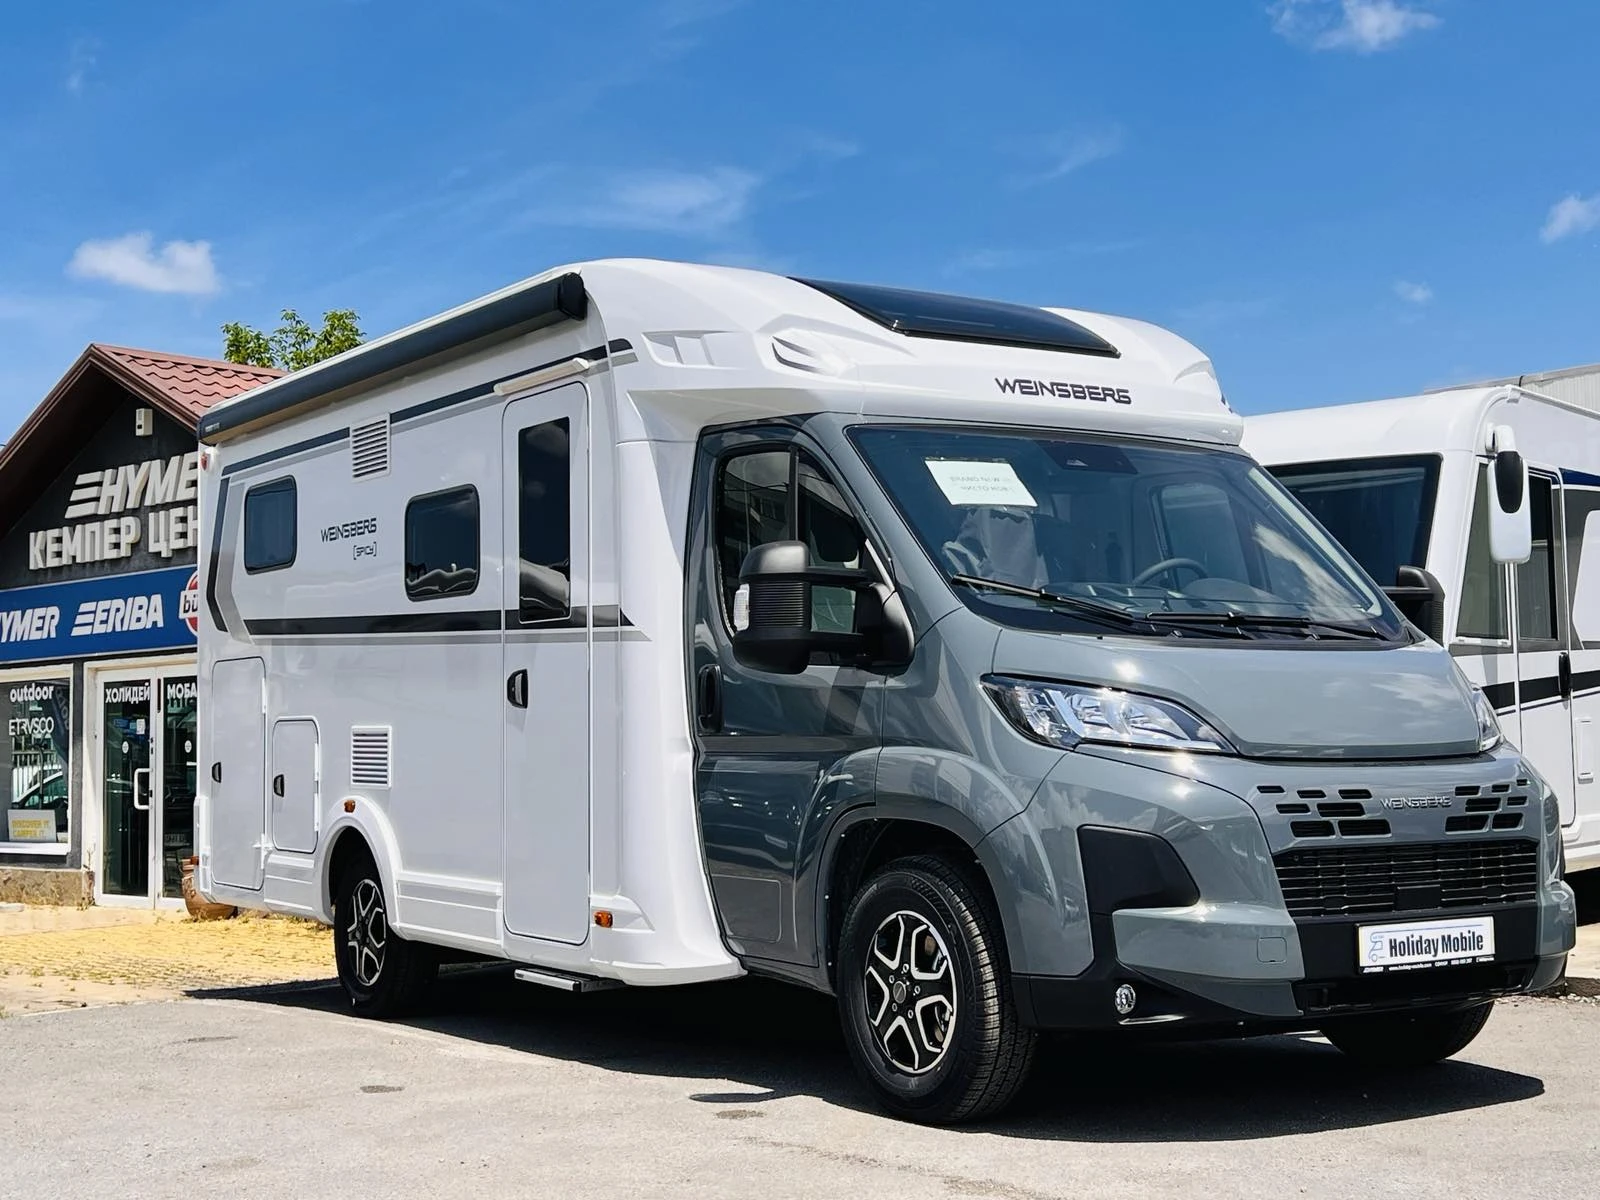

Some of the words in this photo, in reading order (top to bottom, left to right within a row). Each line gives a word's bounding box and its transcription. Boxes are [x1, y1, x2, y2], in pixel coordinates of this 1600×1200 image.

[995, 377, 1132, 404] WEINSBERG
[29, 516, 141, 570] КЕМПЕР
[320, 517, 377, 542] WEINSBERG
[0, 605, 60, 643] YMER
[91, 594, 164, 634] ERIBA
[10, 683, 54, 702] outdoor
[105, 682, 150, 704] ХОЛИДЕЙ
[1380, 796, 1452, 810] WEINSBERG
[1389, 934, 1439, 957] Holiday
[1441, 930, 1484, 953] Mobile
